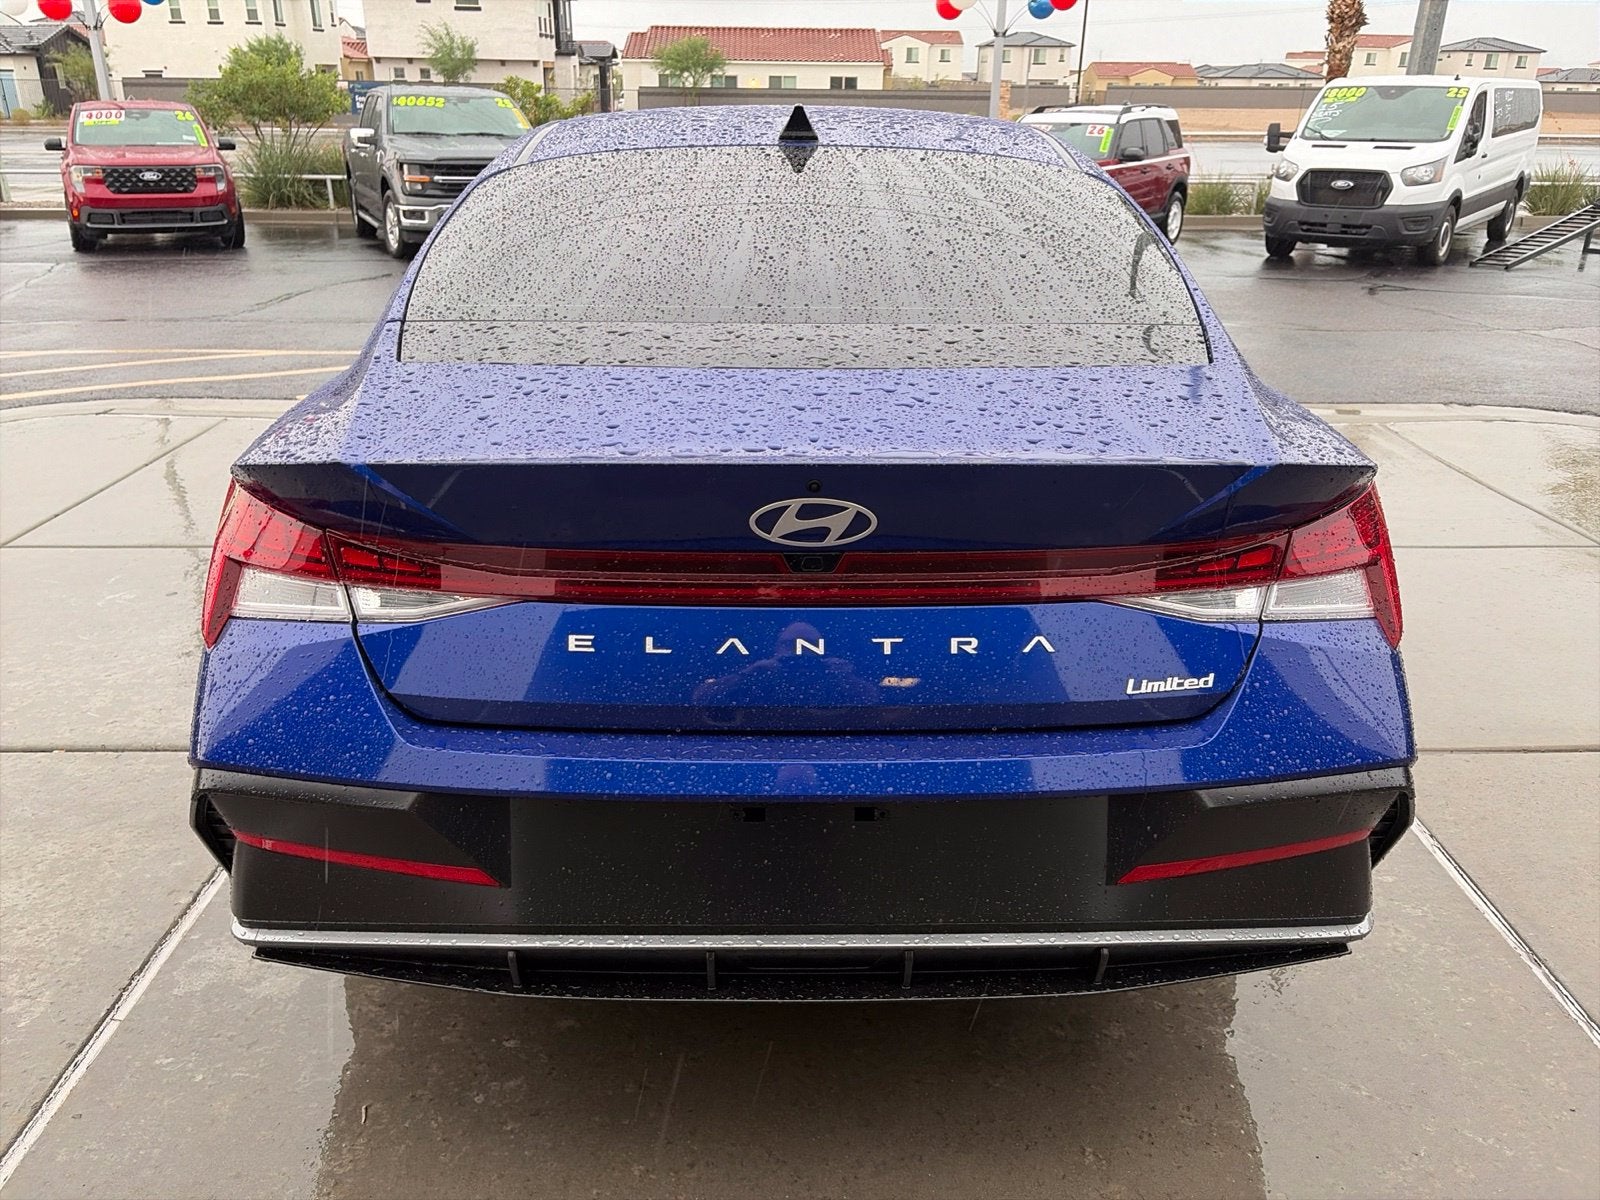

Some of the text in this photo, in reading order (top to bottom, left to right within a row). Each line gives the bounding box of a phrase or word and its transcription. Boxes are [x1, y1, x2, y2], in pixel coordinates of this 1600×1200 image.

[1446, 87, 1469, 98] 25
[1087, 125, 1105, 135] 26
[566, 634, 1057, 656] ELANTRA
[1126, 672, 1215, 695] Limited
